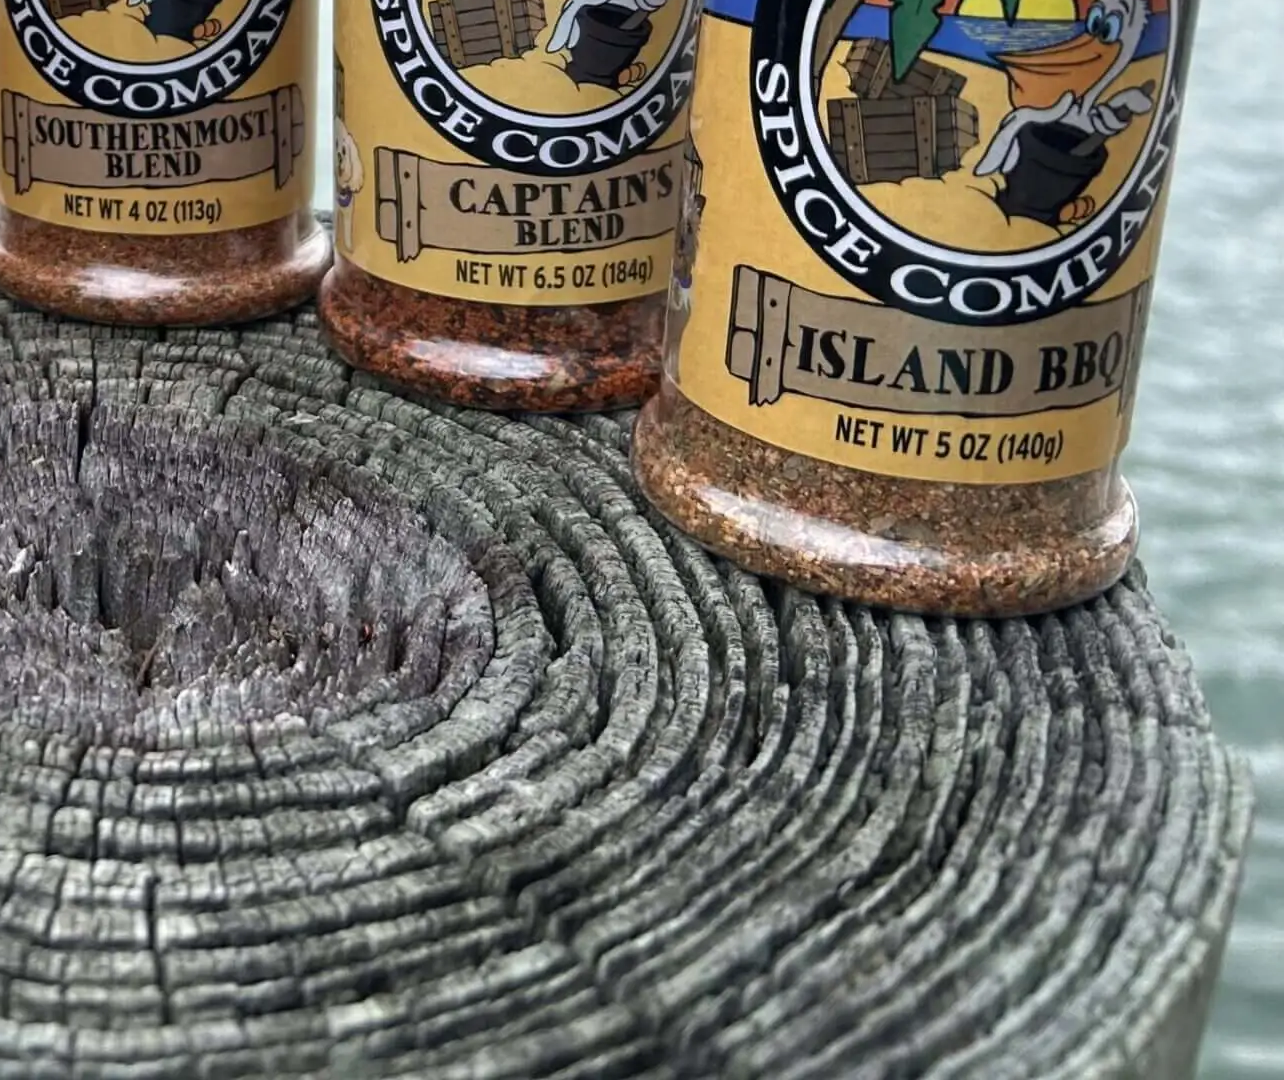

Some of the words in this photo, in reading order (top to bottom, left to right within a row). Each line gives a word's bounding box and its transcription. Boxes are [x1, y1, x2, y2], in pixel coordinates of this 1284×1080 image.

[34, 110, 270, 151] SOUTHERNMOST
[105, 150, 202, 179] BLEND
[449, 161, 674, 218] CAPTAIN'S
[755, 58, 881, 274] SPICE
[890, 85, 1180, 316] COMPANY
[64, 194, 94, 218] NET
[98, 198, 124, 220] WT
[128, 199, 140, 221] 4
[145, 199, 168, 222] OZ
[173, 195, 222, 224] (113g)
[515, 214, 625, 248] BLEND
[455, 259, 493, 285] NET
[498, 263, 528, 288] WT
[533, 264, 565, 289] 6.5
[571, 263, 595, 288] OZ
[601, 254, 654, 288] (184g)
[796, 325, 1014, 396] ISLAND
[1035, 330, 1123, 395] BBQ
[835, 414, 884, 449] NET
[891, 423, 926, 456] WT
[934, 428, 950, 457] 5
[959, 433, 989, 461] OZ
[996, 427, 1064, 464] (140g)
